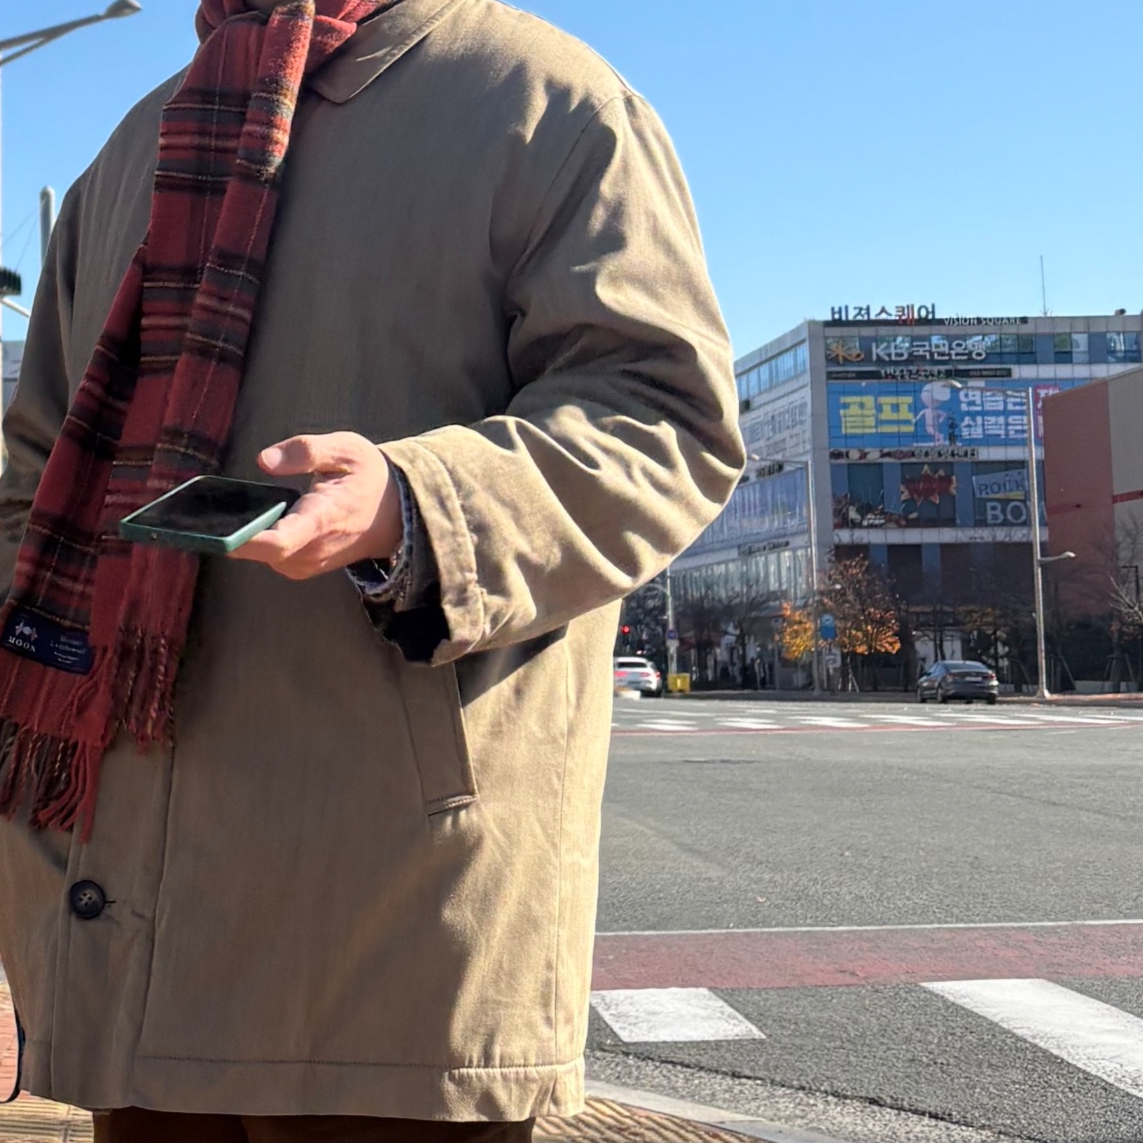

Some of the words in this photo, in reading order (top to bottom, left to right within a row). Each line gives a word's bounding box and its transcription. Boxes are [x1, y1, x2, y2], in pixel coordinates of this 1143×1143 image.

[871, 339, 987, 361] KB국민은행
[839, 394, 915, 436] 골프
[8, 634, 37, 653] MOON
